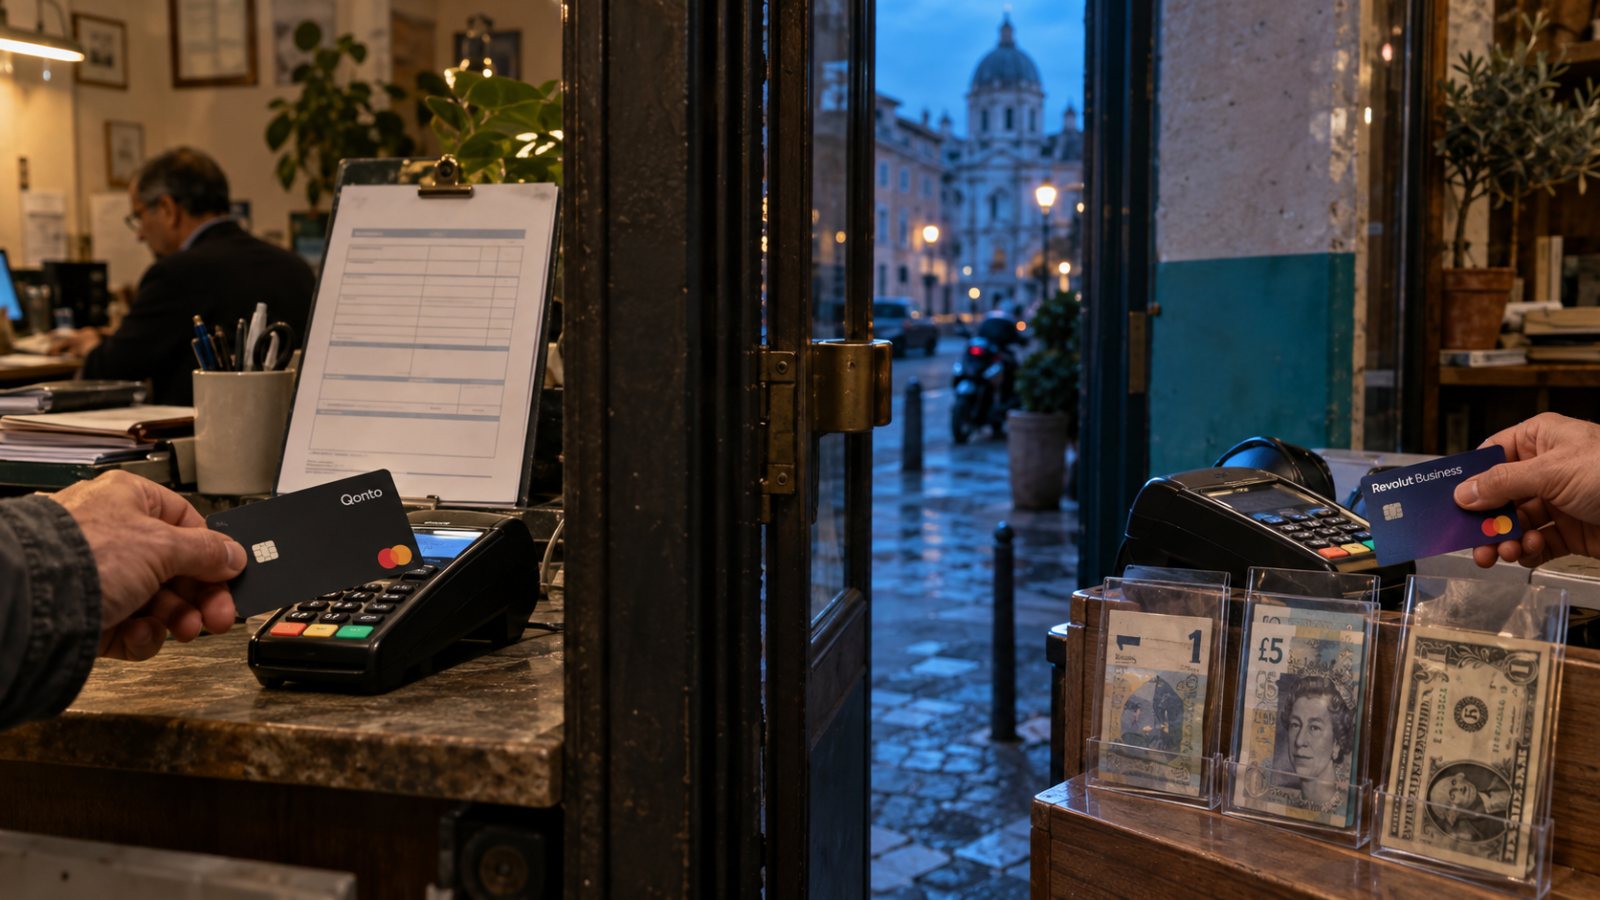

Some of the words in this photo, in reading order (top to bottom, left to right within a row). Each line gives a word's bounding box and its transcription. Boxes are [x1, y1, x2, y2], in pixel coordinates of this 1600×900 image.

[1371, 476, 1414, 494] Revolut
[1415, 466, 1463, 484] Business
[340, 489, 383, 506] Qonto
[1116, 634, 1141, 651] 1
[1188, 629, 1202, 664] 1
[1258, 636, 1284, 664] £5
